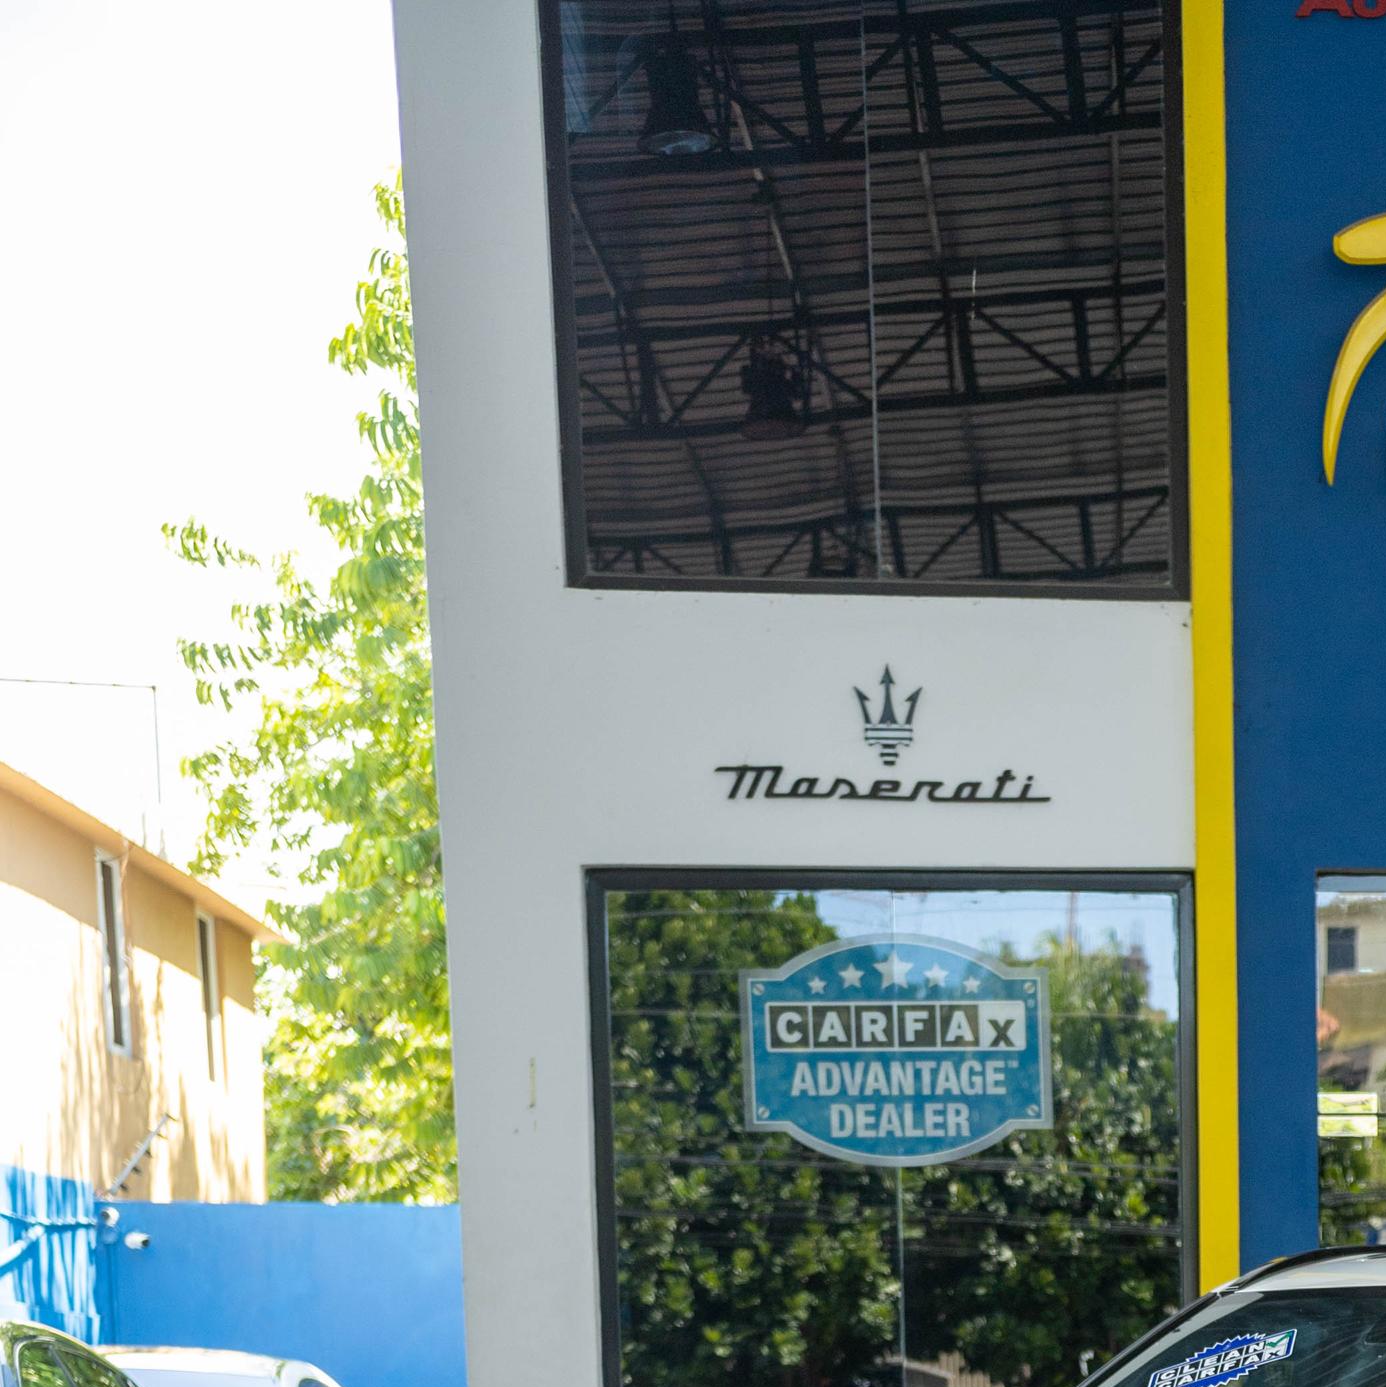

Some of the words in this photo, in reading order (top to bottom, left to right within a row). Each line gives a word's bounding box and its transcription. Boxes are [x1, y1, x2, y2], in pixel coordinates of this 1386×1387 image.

[714, 765, 1051, 803] Maserati
[774, 1009, 1019, 1050] CARFAX
[790, 1060, 1007, 1098] ADVANTAGE
[829, 1102, 971, 1139] DEALER
[1159, 1341, 1266, 1381] CLEAN
